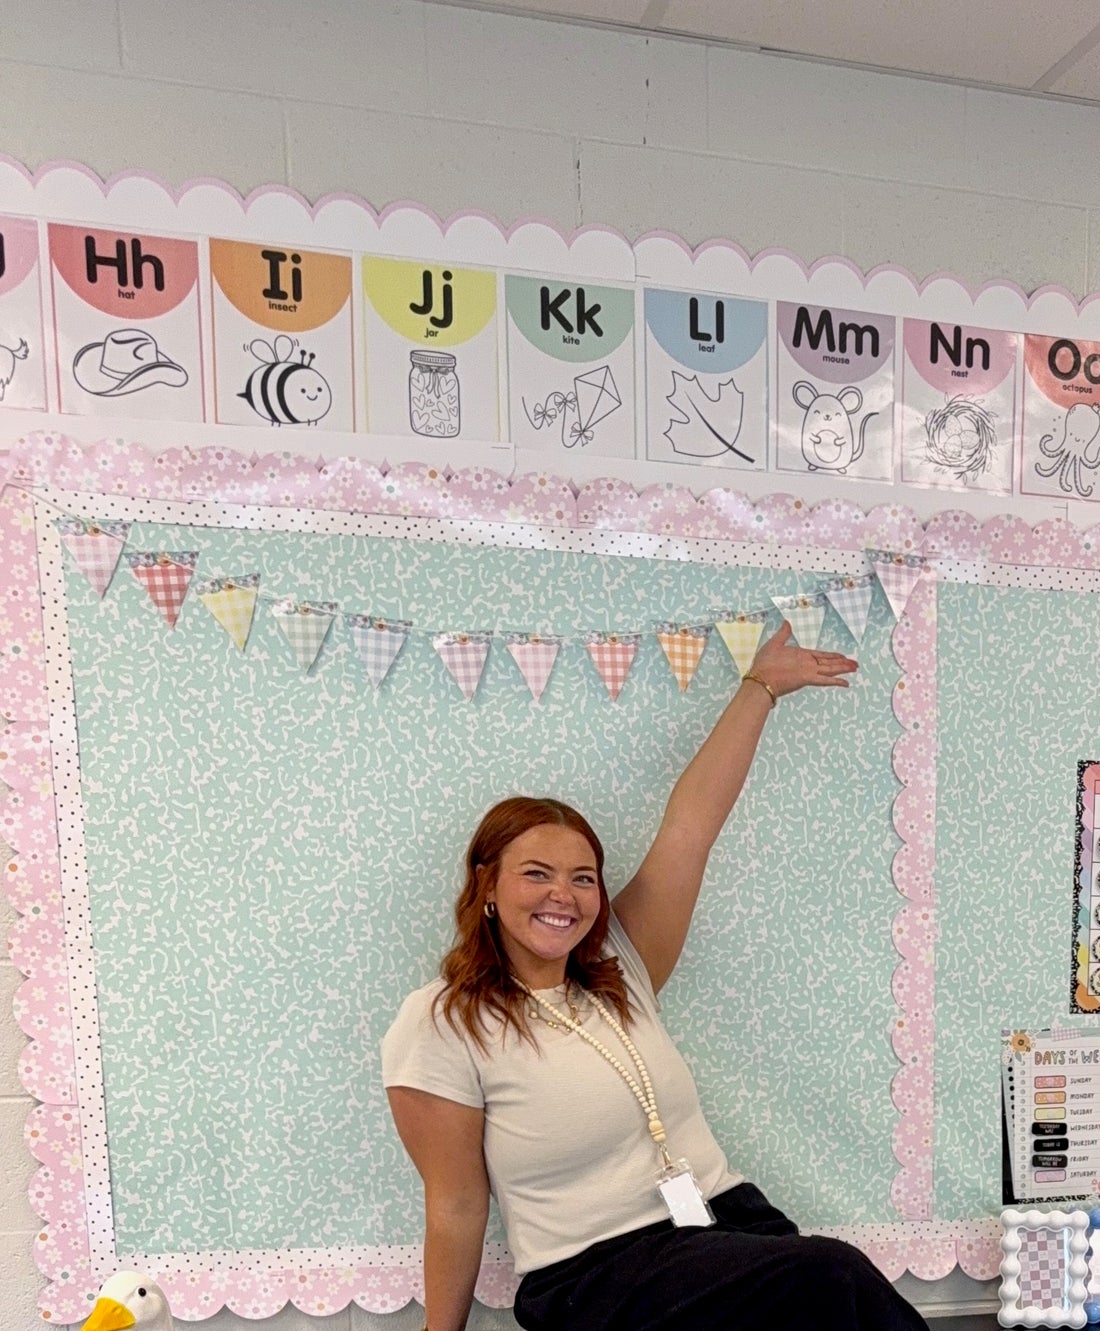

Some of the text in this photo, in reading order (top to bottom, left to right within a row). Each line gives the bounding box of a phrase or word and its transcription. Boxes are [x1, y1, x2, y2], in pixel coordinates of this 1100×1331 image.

[85, 236, 164, 291] Hh
[262, 250, 302, 302] Ii
[118, 289, 135, 300] hat
[409, 270, 453, 328] Jj
[268, 302, 298, 313] insect
[540, 286, 604, 338] Kk
[690, 297, 724, 343] Ll
[424, 328, 439, 339] jar
[792, 306, 880, 358] Mm
[562, 335, 580, 346] kite
[930, 322, 990, 370] Nn
[699, 344, 716, 354] leaf
[822, 354, 850, 365] mouse
[951, 370, 968, 378] nest
[1062, 383, 1092, 394] octopus
[1034, 1050, 1066, 1066] DAYS
